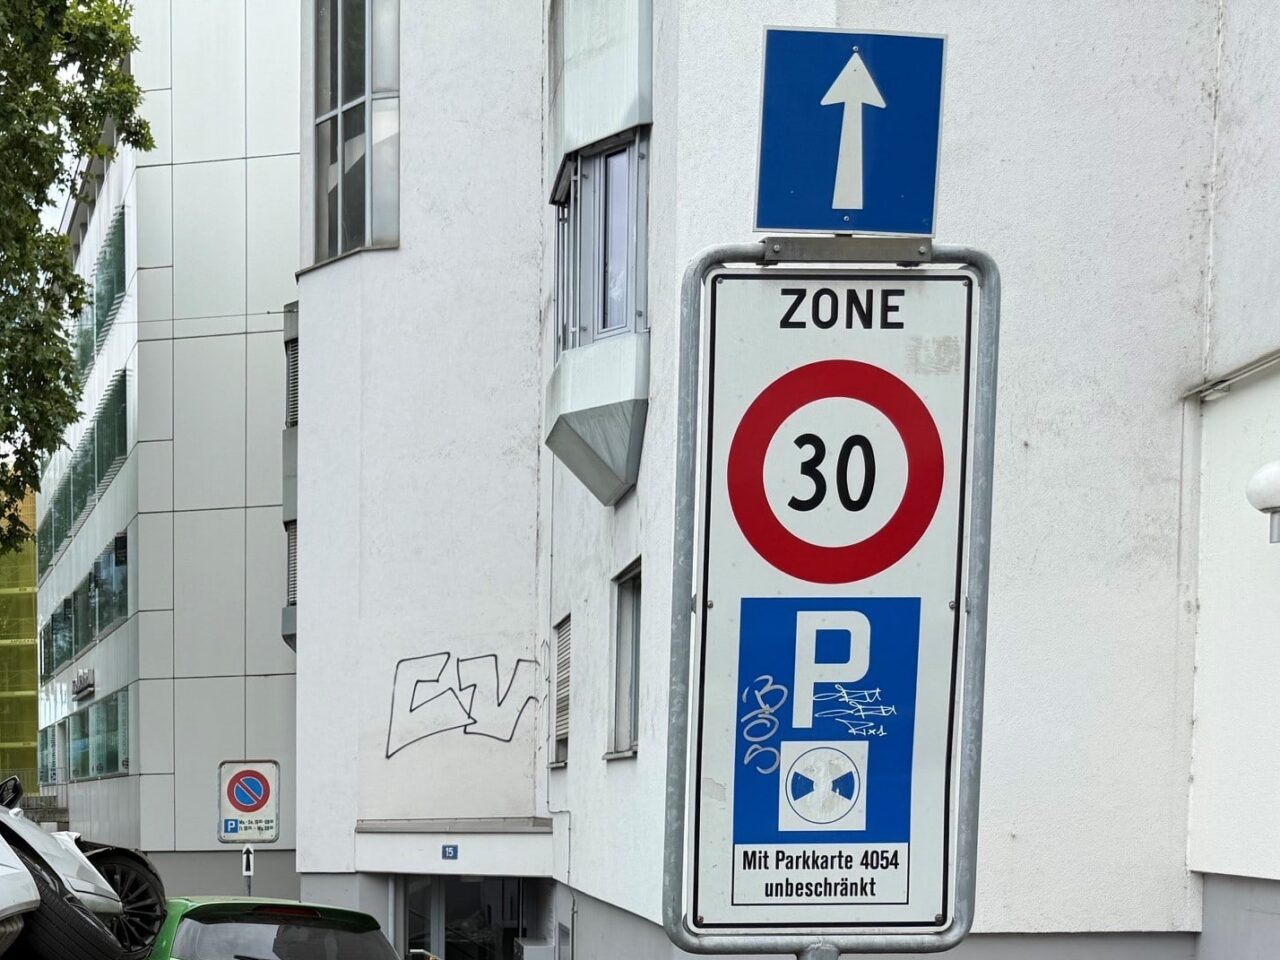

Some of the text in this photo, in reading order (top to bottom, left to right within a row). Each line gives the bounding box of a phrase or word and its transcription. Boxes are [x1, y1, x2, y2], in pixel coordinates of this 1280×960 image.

[780, 288, 906, 329] ZONE
[787, 433, 876, 512] 30
[792, 611, 870, 728] P
[227, 820, 236, 832] P
[445, 847, 455, 857] 15
[742, 849, 900, 871] Mit Parkkarte 4054
[764, 877, 876, 898] unbeschränkt
